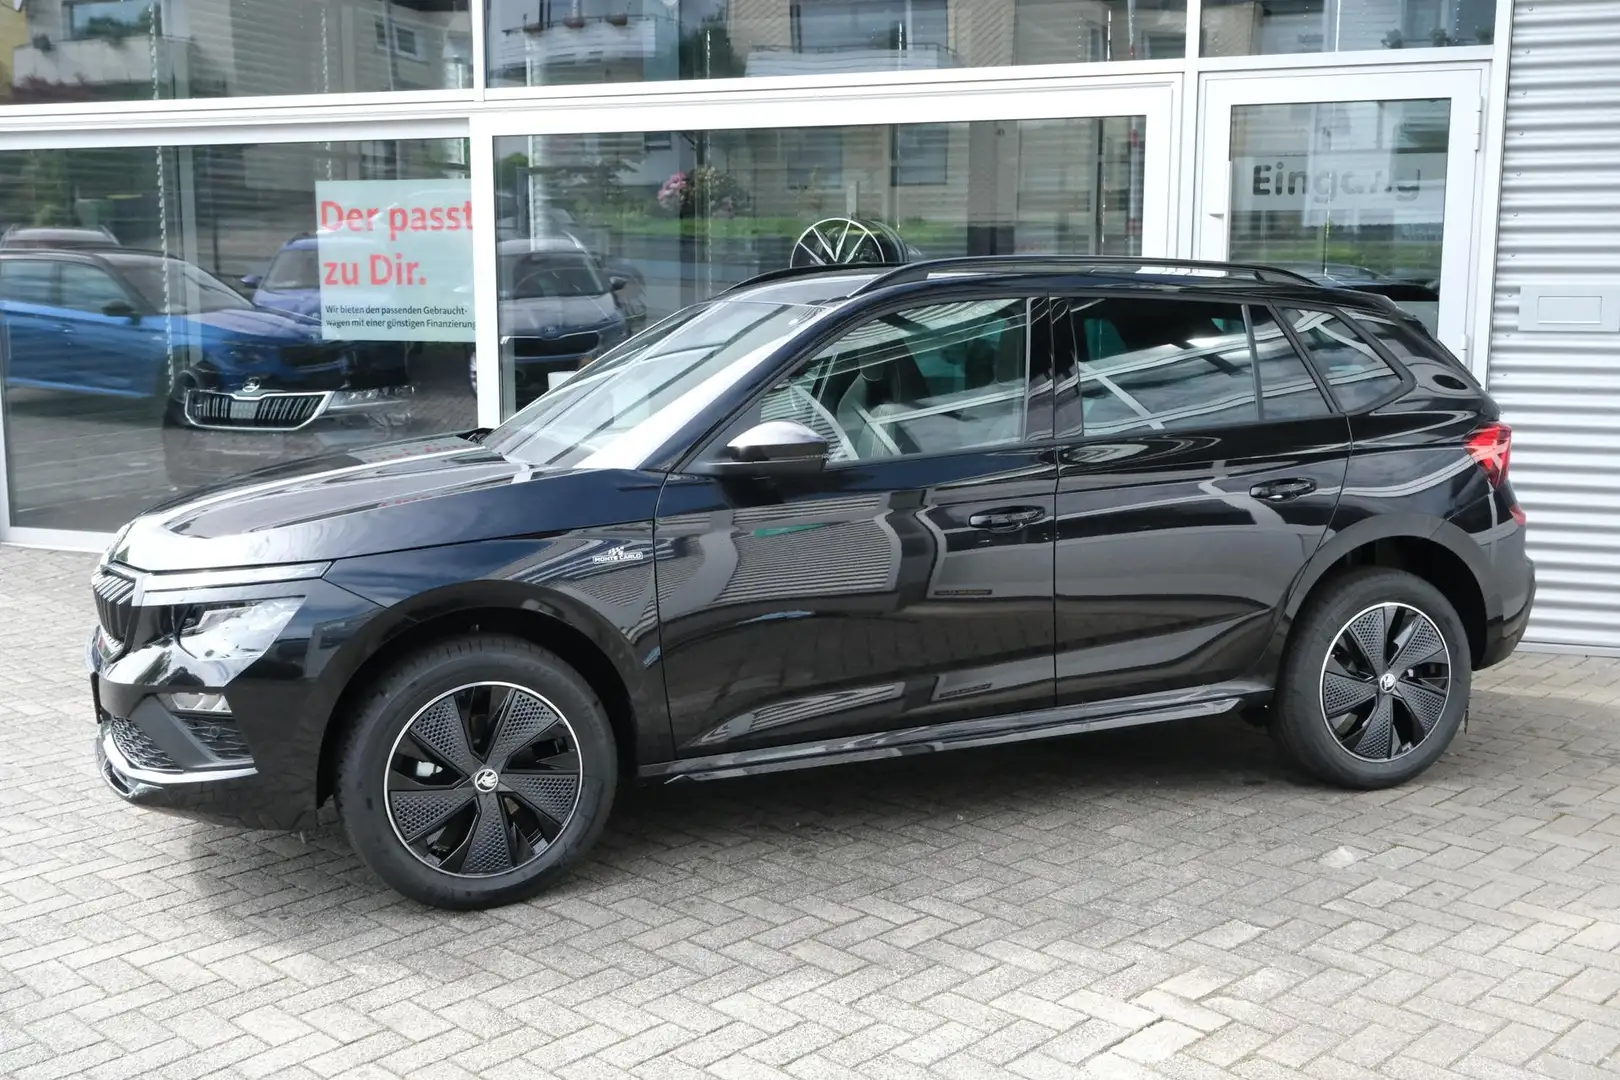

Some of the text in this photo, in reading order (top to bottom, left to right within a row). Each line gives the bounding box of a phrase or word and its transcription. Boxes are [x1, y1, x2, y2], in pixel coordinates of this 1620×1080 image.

[321, 200, 473, 241] Der passt
[323, 253, 427, 286] zu Dir.
[325, 304, 467, 316] Wir bieten den passenden Gebraucht-
[325, 319, 350, 329] wagen
[351, 318, 365, 327] mit
[366, 318, 386, 328] einer
[386, 318, 425, 330] günstigen
[594, 553, 642, 563] MONTE CARLO
